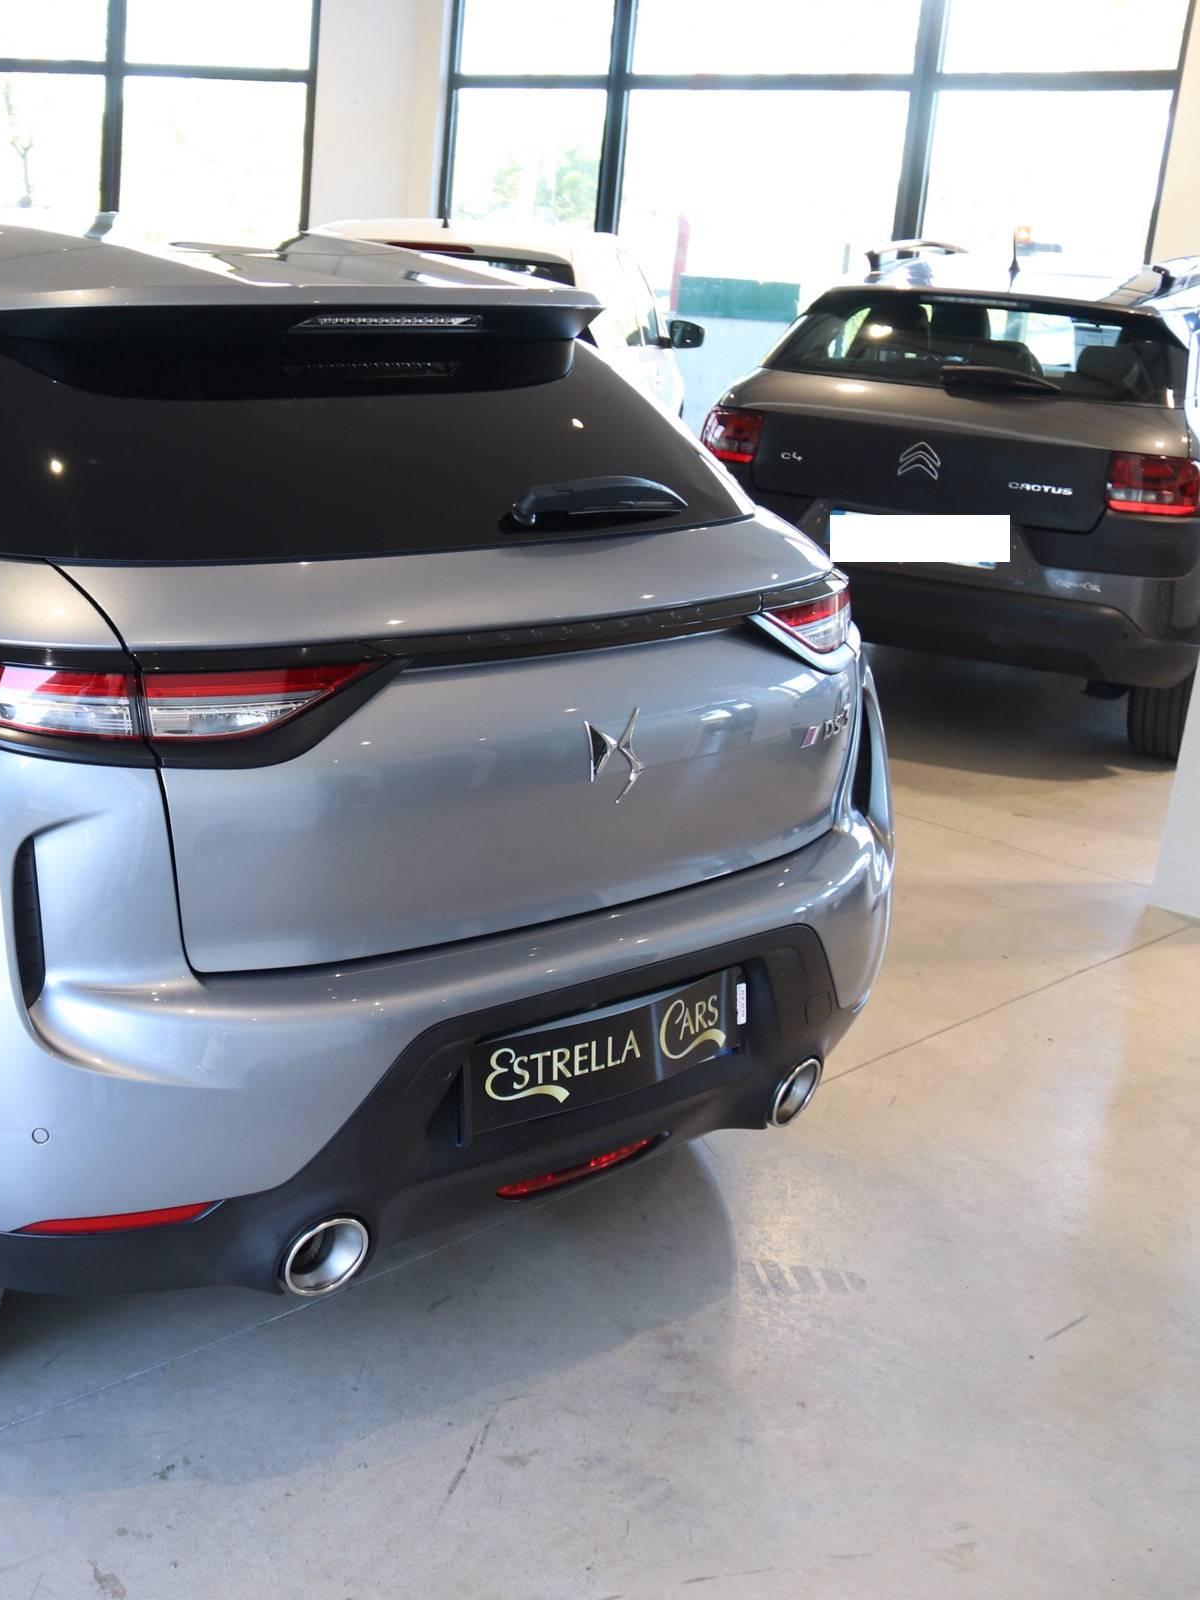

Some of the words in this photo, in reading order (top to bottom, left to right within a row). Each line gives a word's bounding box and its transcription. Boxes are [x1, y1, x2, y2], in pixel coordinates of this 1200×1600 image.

[780, 451, 803, 461] C4
[1008, 481, 1073, 496] CACTUS
[484, 1029, 641, 1104] ESTRELLA
[659, 994, 727, 1060] CARS
